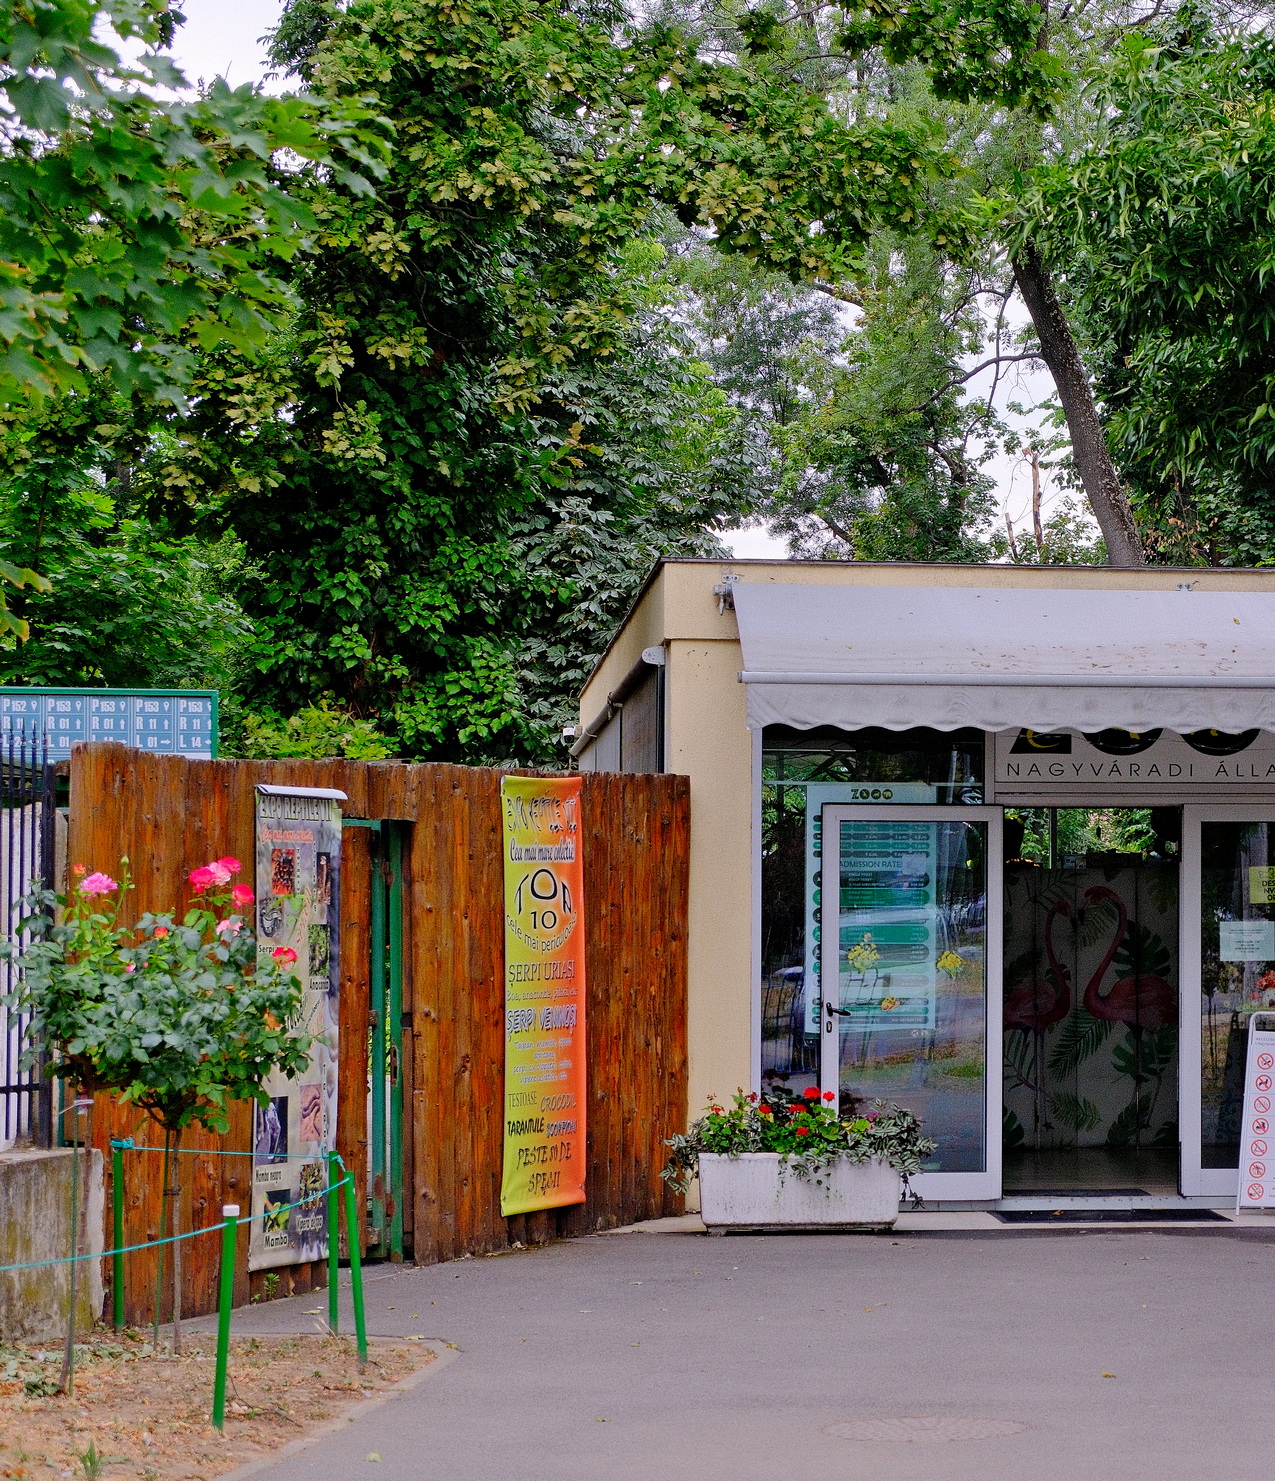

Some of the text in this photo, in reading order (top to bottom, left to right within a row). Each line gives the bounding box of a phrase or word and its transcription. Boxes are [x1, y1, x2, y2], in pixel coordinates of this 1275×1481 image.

[47, 716, 70, 730] R 01
[92, 717, 114, 730] R 01
[136, 717, 157, 730] R 11
[180, 717, 201, 730] R 11
[47, 735, 70, 748] L 01
[136, 735, 158, 748] L 01
[179, 735, 187, 748] L
[1006, 759, 1194, 777] NAGYVÁRADI
[260, 796, 282, 818] EXPO
[284, 797, 320, 821] REPTILE
[514, 869, 572, 915] TOP
[530, 910, 557, 930] 10
[507, 914, 522, 940] cele
[524, 934, 539, 951] mai
